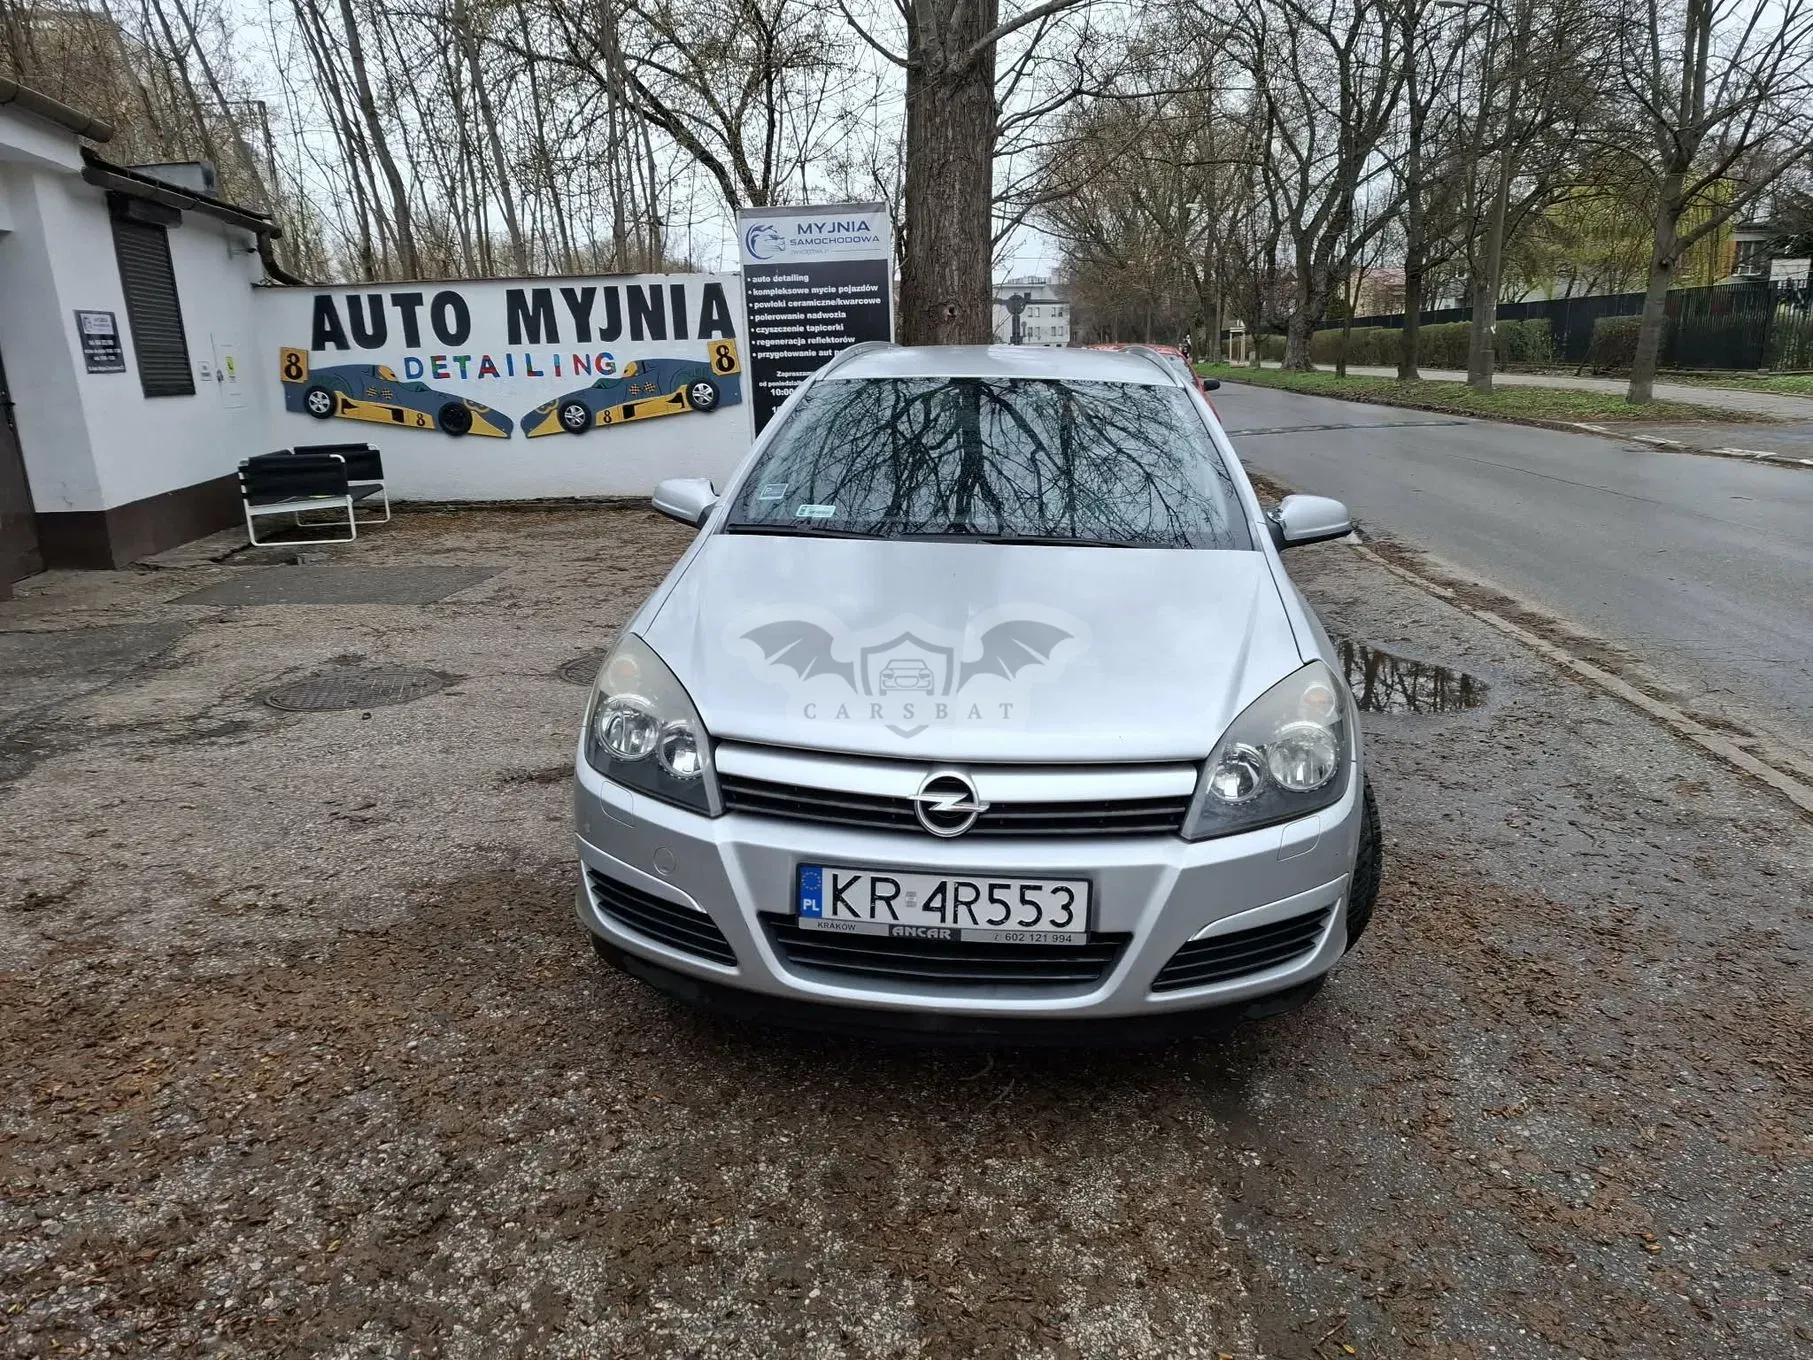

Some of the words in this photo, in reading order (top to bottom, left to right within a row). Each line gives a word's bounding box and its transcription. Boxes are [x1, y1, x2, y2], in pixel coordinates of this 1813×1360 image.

[797, 220, 871, 235] MYJNIA
[789, 235, 880, 246] SAMOCHODOWA
[772, 274, 809, 283] detailing
[753, 287, 809, 296] kompleksowe
[811, 285, 837, 295] mycie
[838, 284, 879, 294] pojazdów
[788, 297, 881, 307] ceramiczne/kwarcowe
[311, 290, 471, 352] AUTO
[506, 282, 736, 345] MYJNIA
[755, 312, 805, 322] polerowanie
[806, 311, 846, 319] nadwozia
[755, 324, 805, 334] czyszczenie
[806, 323, 844, 332] tapicerki
[756, 337, 806, 347] regeneracja
[807, 335, 855, 344] reflektorów
[715, 345, 735, 372] 8
[757, 349, 817, 359] przygotowanie
[283, 353, 301, 379] 8
[404, 351, 617, 380] DETAILING
[803, 898, 820, 911] PL
[831, 873, 901, 921] KR
[921, 880, 1075, 928] 4R553
[891, 926, 952, 941] ANCAR
[1005, 933, 1025, 942] 602
[1029, 934, 1048, 943] 121
[1052, 934, 1072, 944] 994
